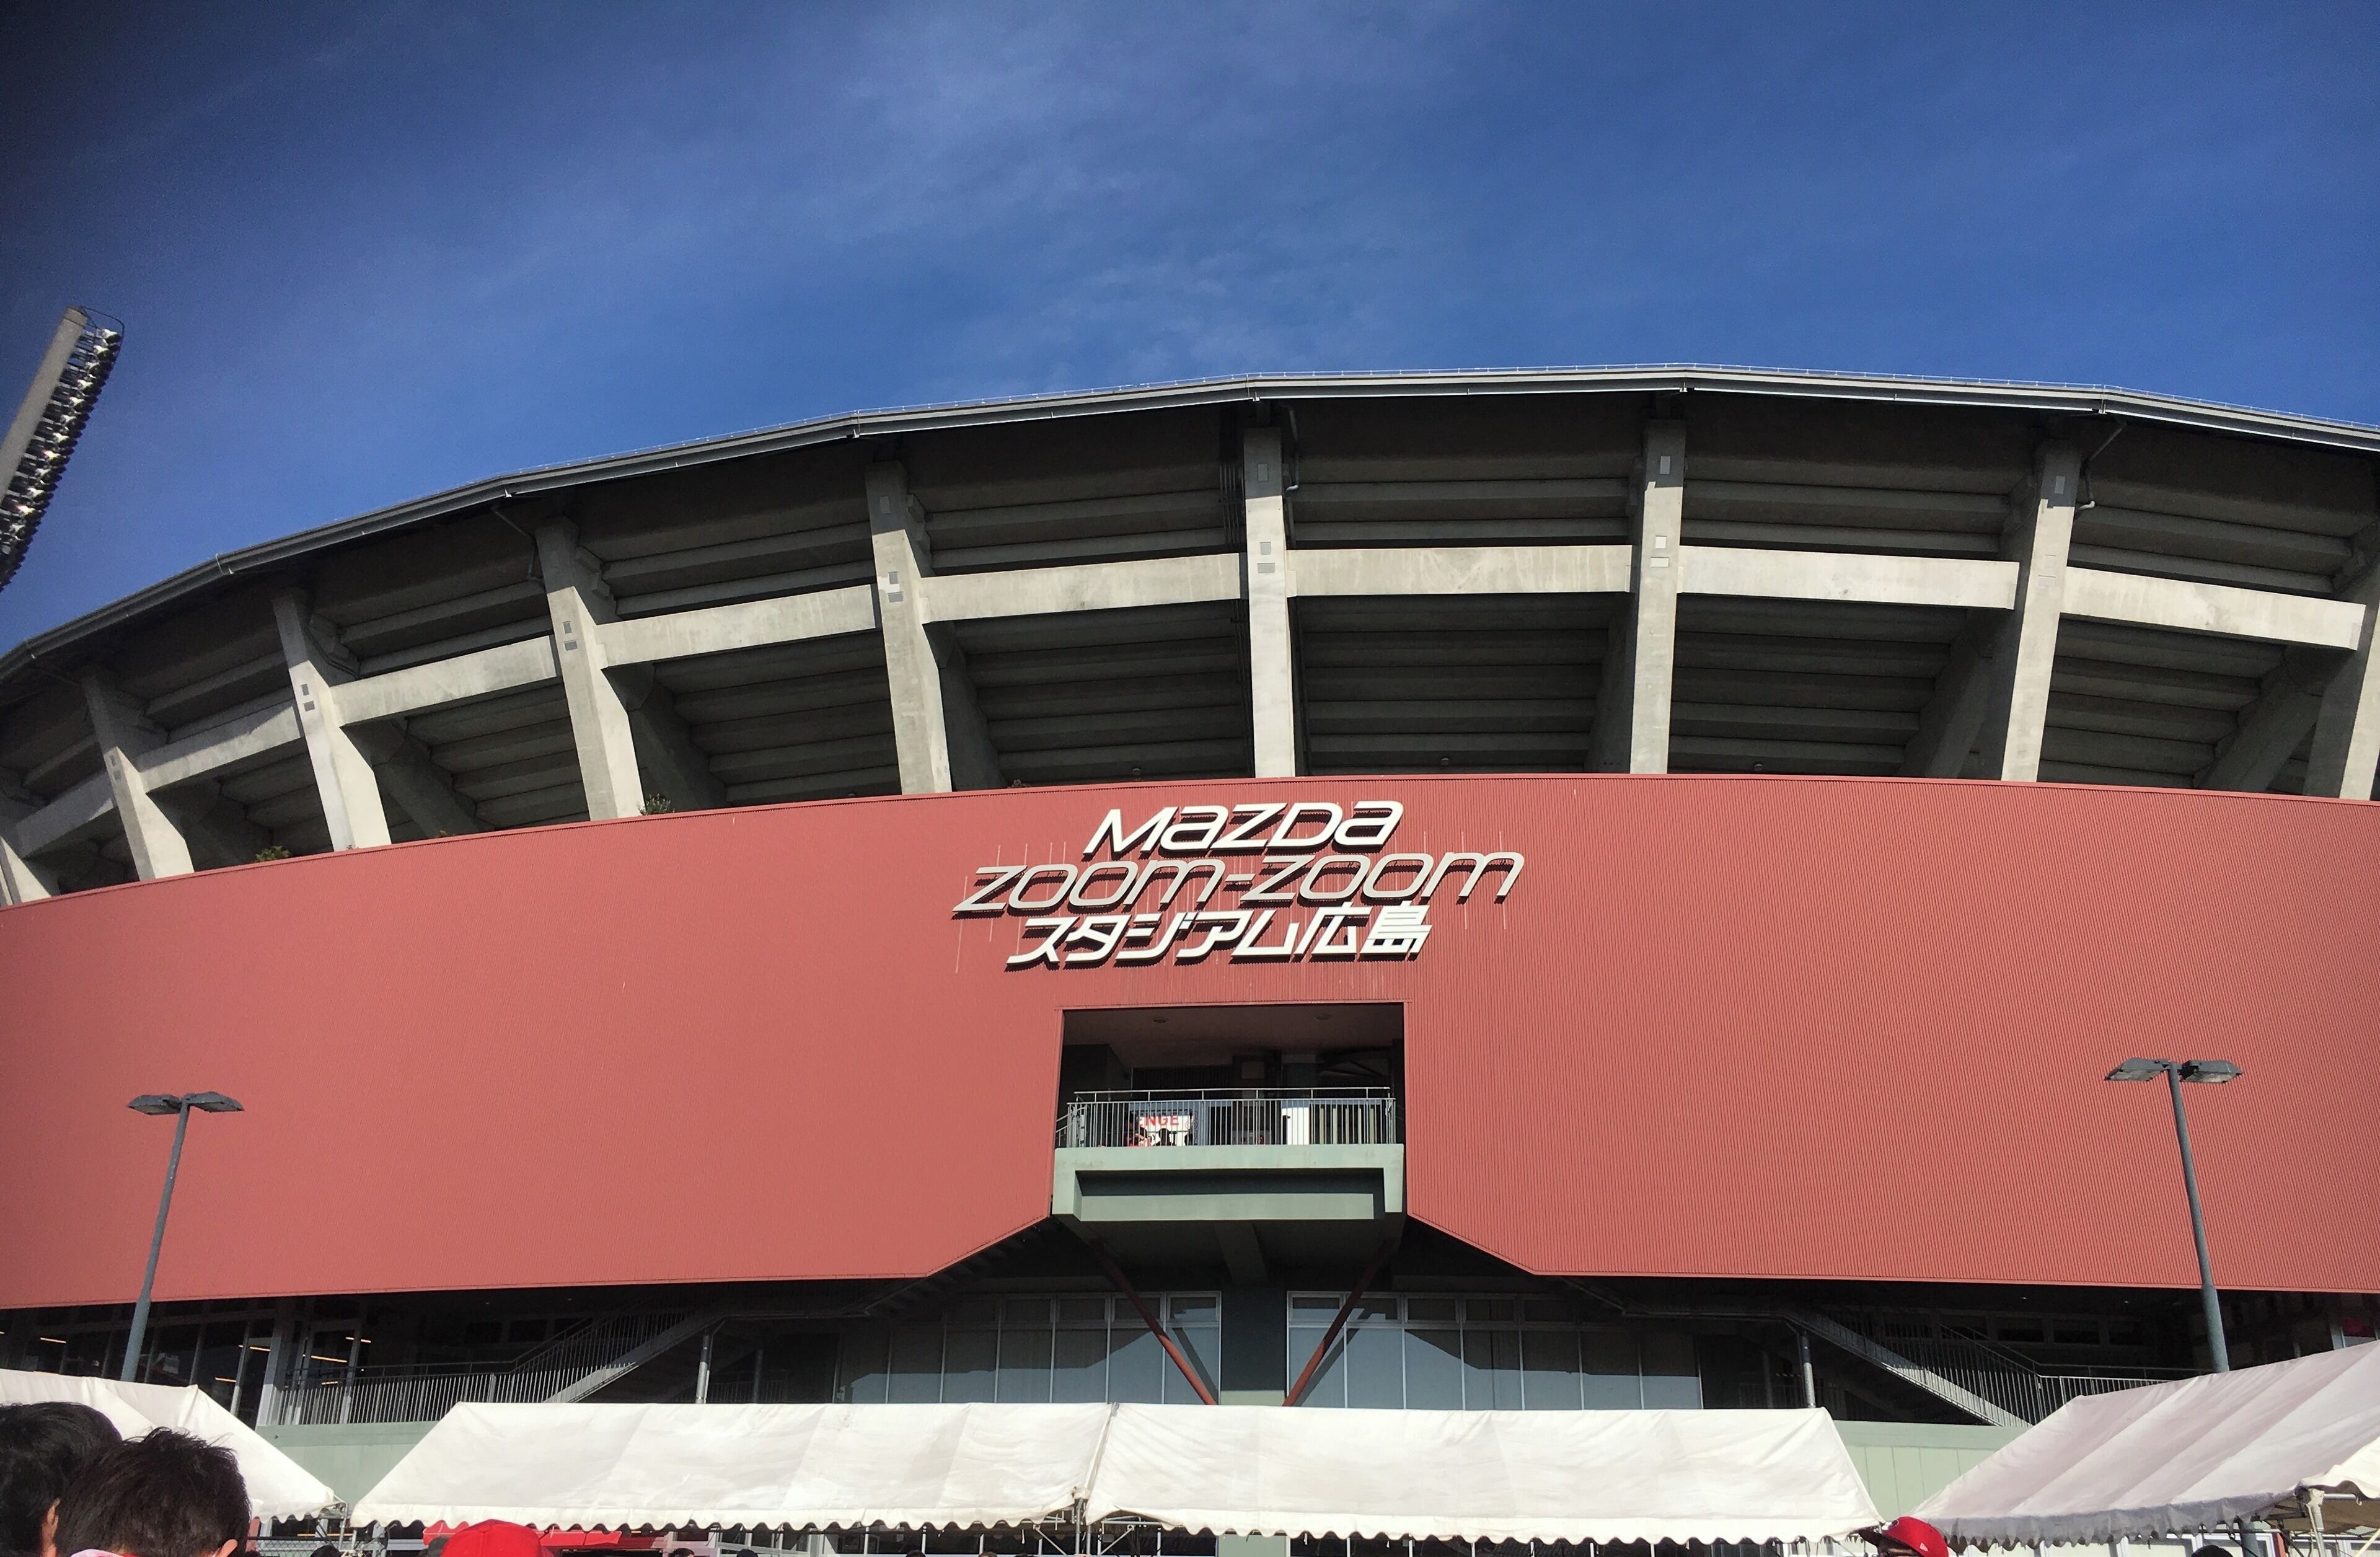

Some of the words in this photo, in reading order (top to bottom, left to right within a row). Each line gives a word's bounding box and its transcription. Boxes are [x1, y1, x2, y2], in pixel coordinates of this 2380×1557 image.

[1007, 901, 1433, 964] スタジアム広島
